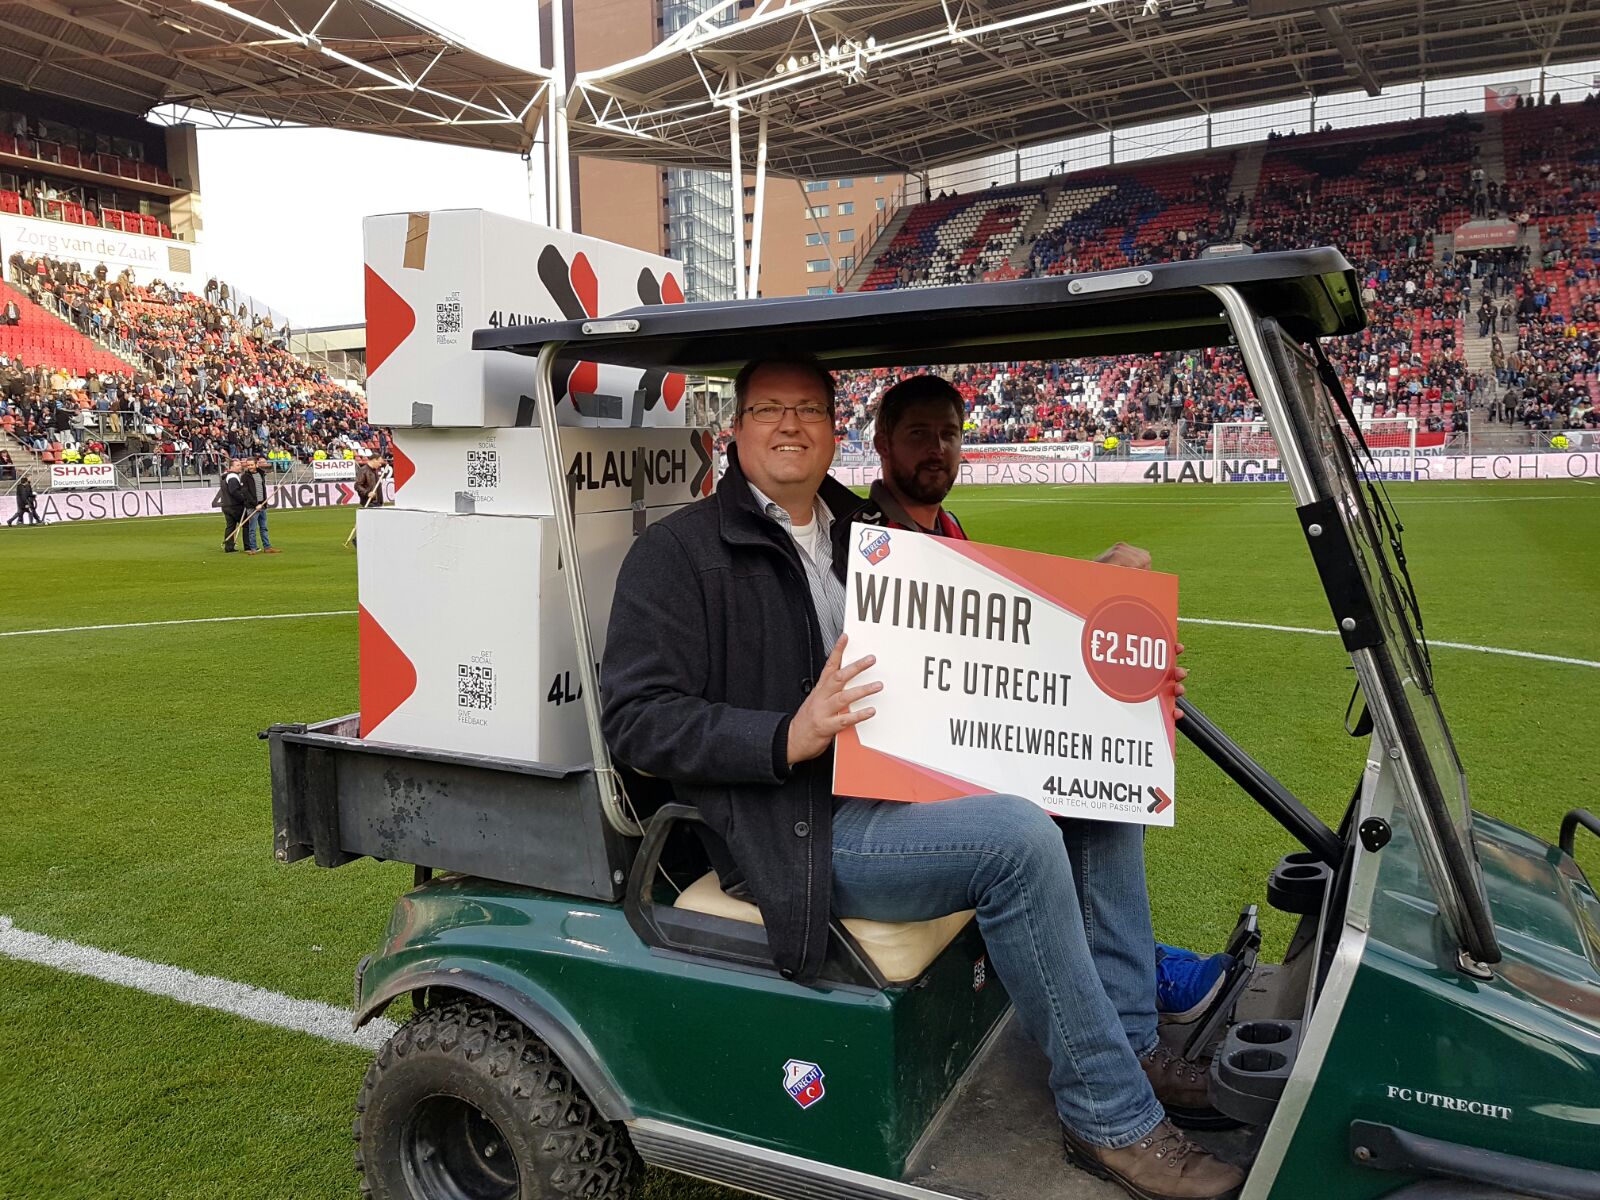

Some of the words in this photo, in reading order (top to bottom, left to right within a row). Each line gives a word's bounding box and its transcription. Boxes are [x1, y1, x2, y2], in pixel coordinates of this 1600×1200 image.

[16, 226, 58, 252] Zorg
[61, 237, 92, 252] van
[96, 239, 115, 255] de
[117, 242, 157, 262] Zaak
[54, 466, 112, 477] SHARP
[315, 461, 354, 470] SHARP
[986, 462, 1097, 484] PASSION
[53, 479, 85, 487] Document
[86, 478, 113, 486] Solutions
[863, 532, 889, 557] UTRECHT
[855, 571, 1032, 645] WINNAAR
[1091, 629, 1167, 670] €2.500
[923, 656, 951, 692] FC
[963, 661, 1072, 707] UTRECHT
[458, 717, 488, 726] FEEDBACK
[950, 718, 1092, 761] WINKELWAGEN
[1101, 736, 1153, 768] ACTIE
[1042, 775, 1142, 804] 4LAUNCH
[1042, 796, 1064, 805] YOUR
[1090, 801, 1107, 810] OUR
[1109, 802, 1142, 813] PASSION
[790, 1067, 820, 1097] UTRECHT
[793, 1065, 800, 1077] F
[806, 1086, 815, 1099] C
[1386, 1085, 1412, 1101] FC
[1415, 1090, 1512, 1120] UTRECHT
